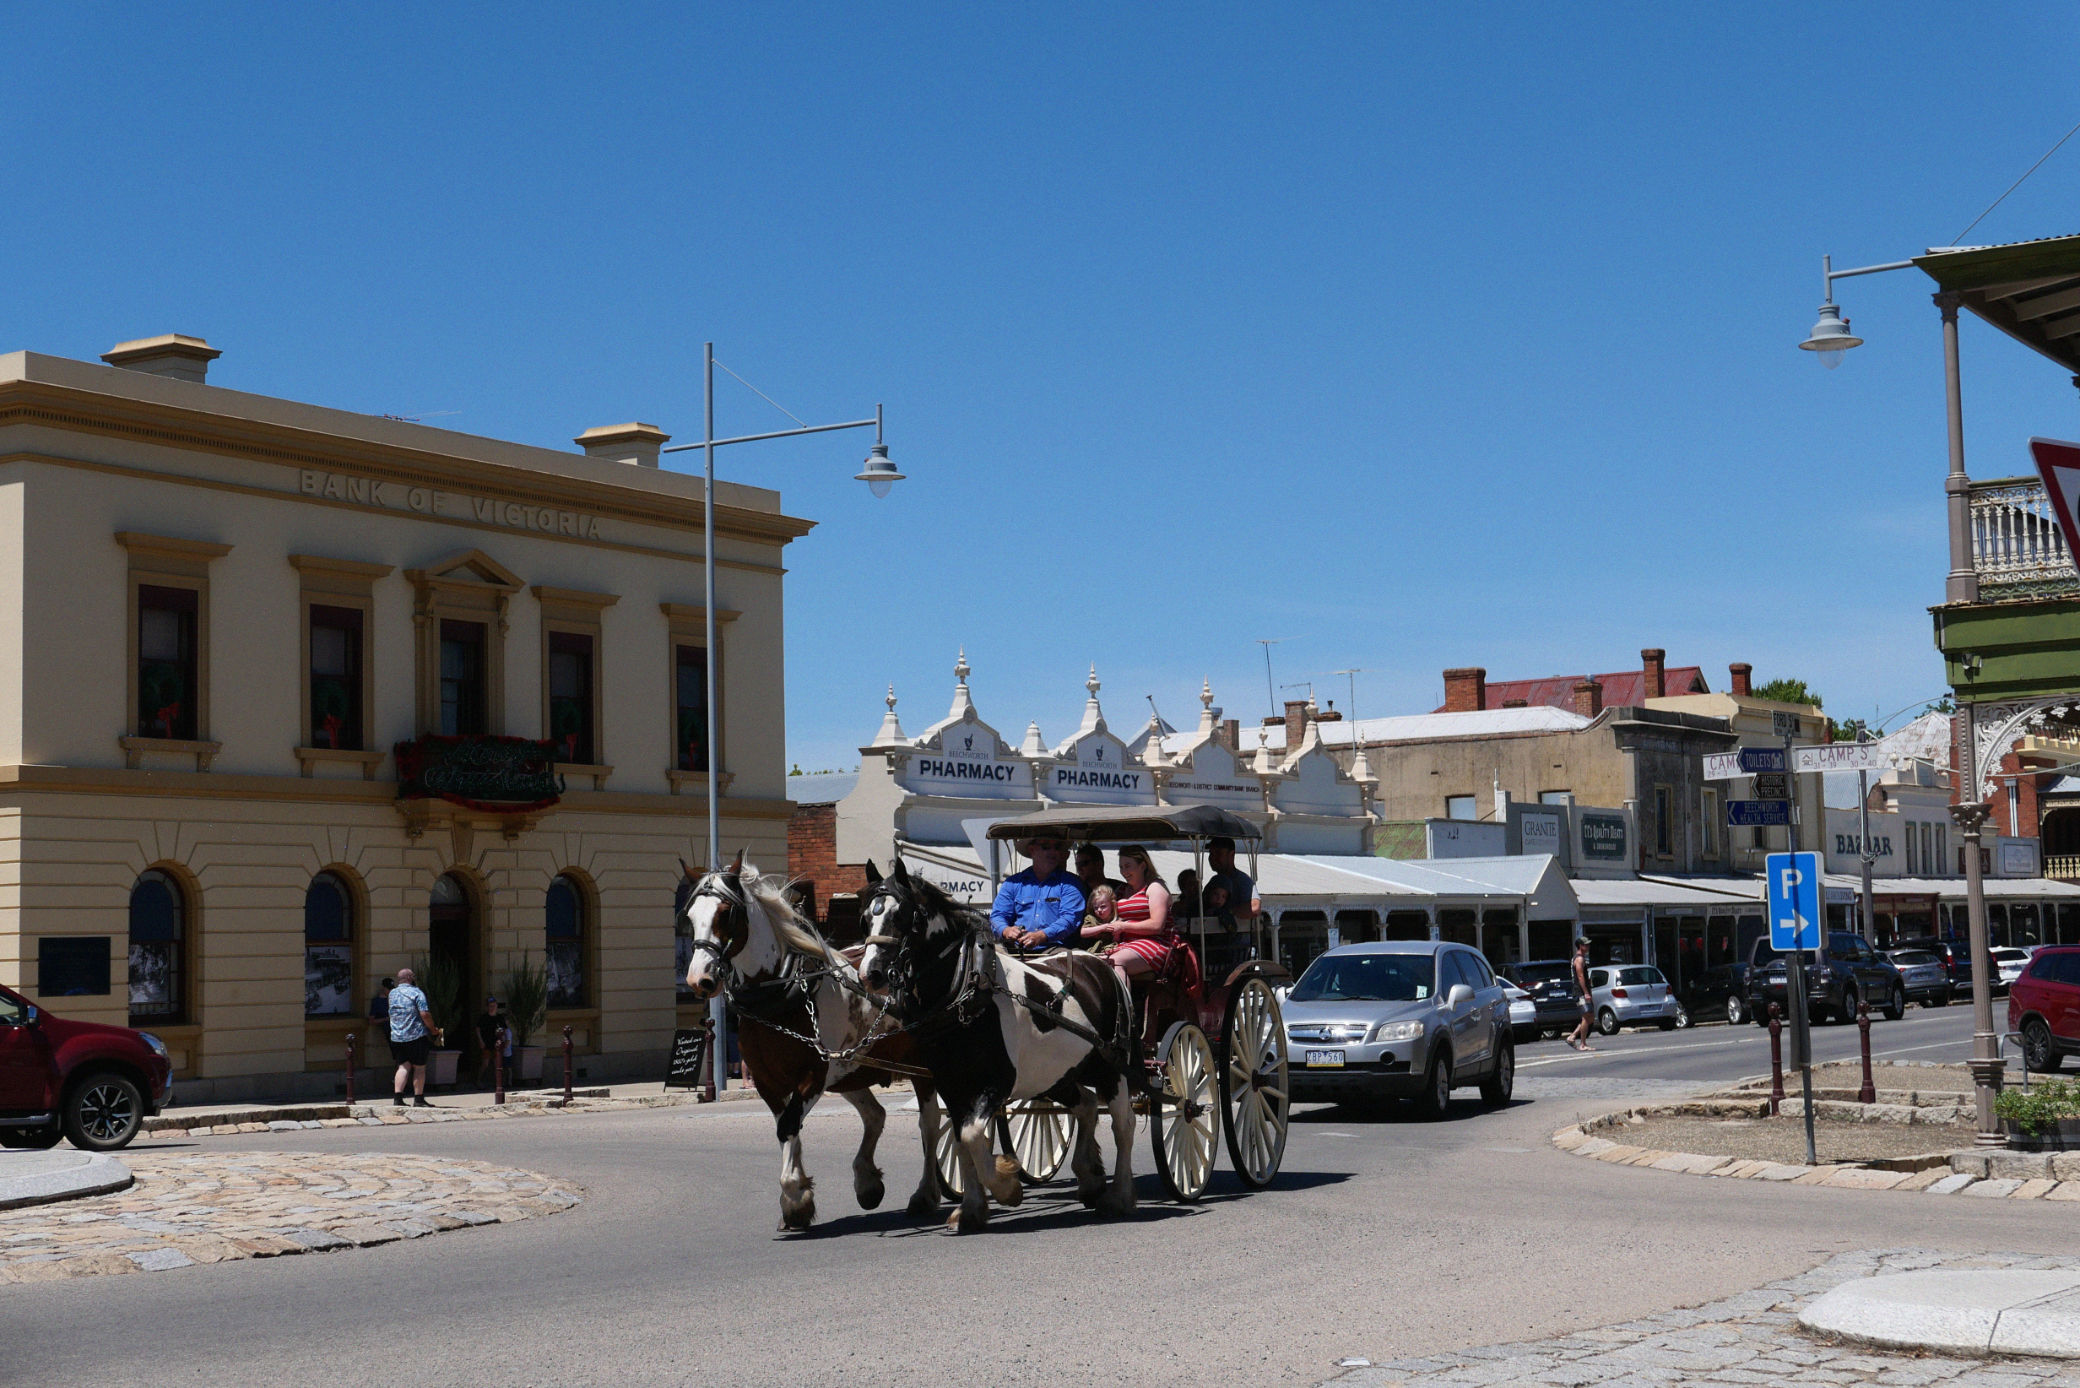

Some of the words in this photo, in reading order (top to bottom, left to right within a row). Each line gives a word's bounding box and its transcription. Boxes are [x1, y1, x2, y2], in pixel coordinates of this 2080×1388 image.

[300, 470, 386, 505] BANK
[407, 486, 448, 513] OF
[472, 496, 601, 539] VICTORIA
[1745, 752, 1771, 768] TOILETS
[1819, 747, 1854, 762] CAMP
[919, 759, 1015, 782] PHARMACY
[1710, 755, 1740, 771] CAM
[1057, 769, 1140, 789] PHARMACY
[1761, 786, 1784, 798] PRECINCT
[1744, 802, 1779, 812] BEECHWORTH
[1763, 813, 1785, 824] SERVICE
[940, 880, 984, 893] RMACY
[1781, 868, 1803, 899] P
